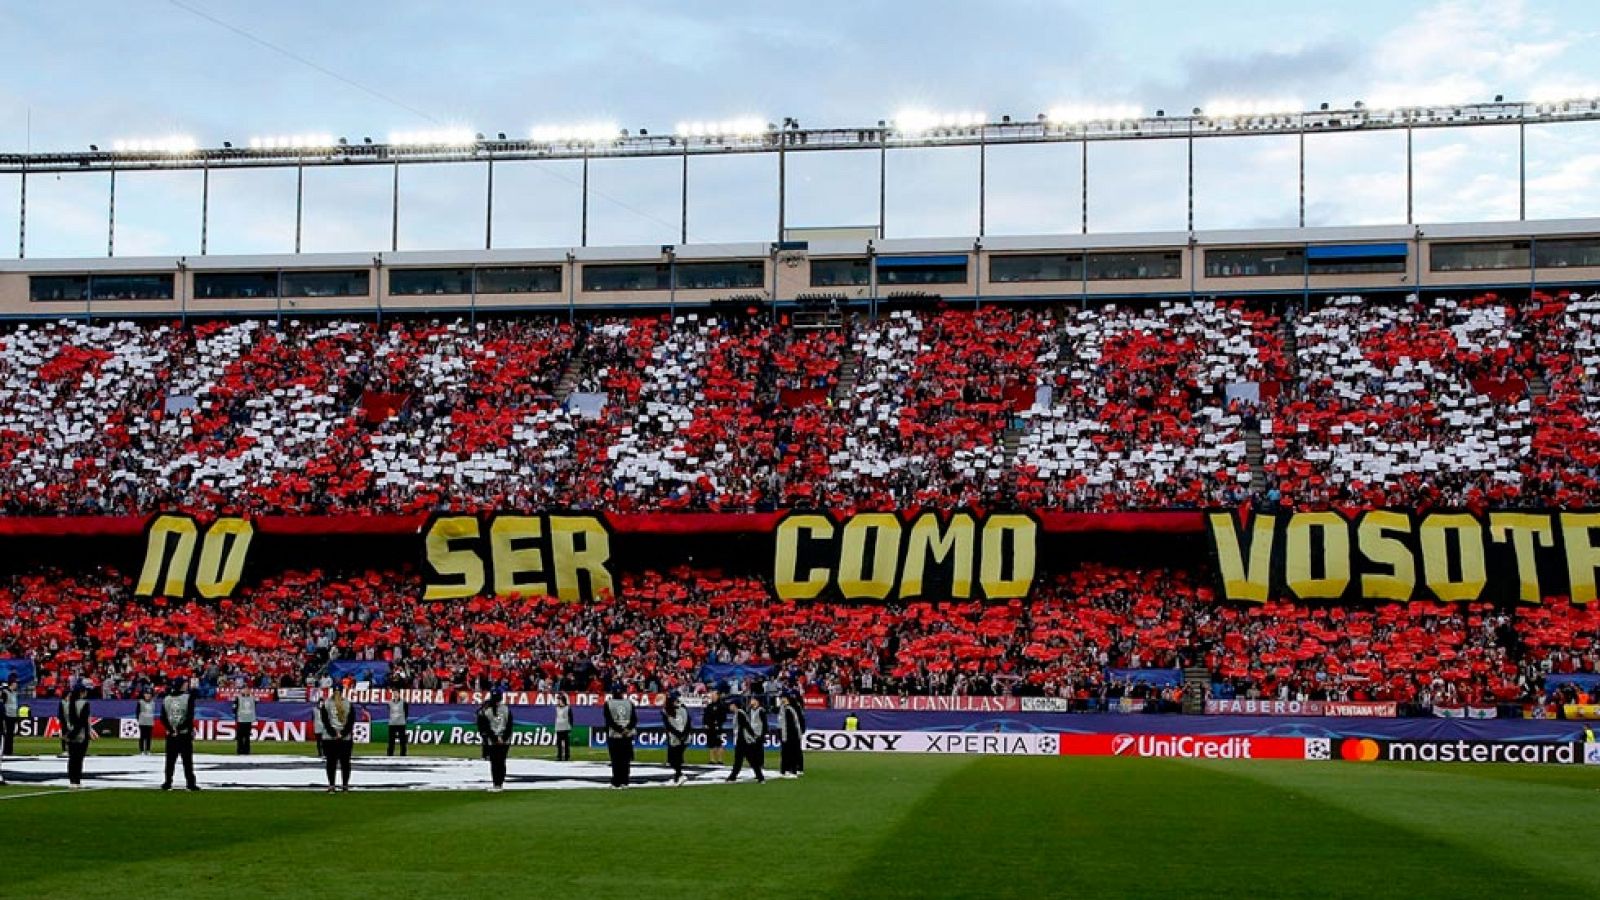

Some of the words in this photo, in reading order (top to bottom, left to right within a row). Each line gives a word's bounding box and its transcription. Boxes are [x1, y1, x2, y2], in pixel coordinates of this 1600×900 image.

[134, 515, 253, 599] NO
[423, 515, 613, 600] SER
[774, 513, 1036, 600] COMO
[913, 697, 1006, 711] CANILLAS
[1219, 700, 1301, 713] FABERO
[806, 732, 902, 751] SONY
[926, 734, 1028, 754] XPERIA
[1138, 736, 1252, 759] UniCredit
[1388, 739, 1574, 763] mastercard
